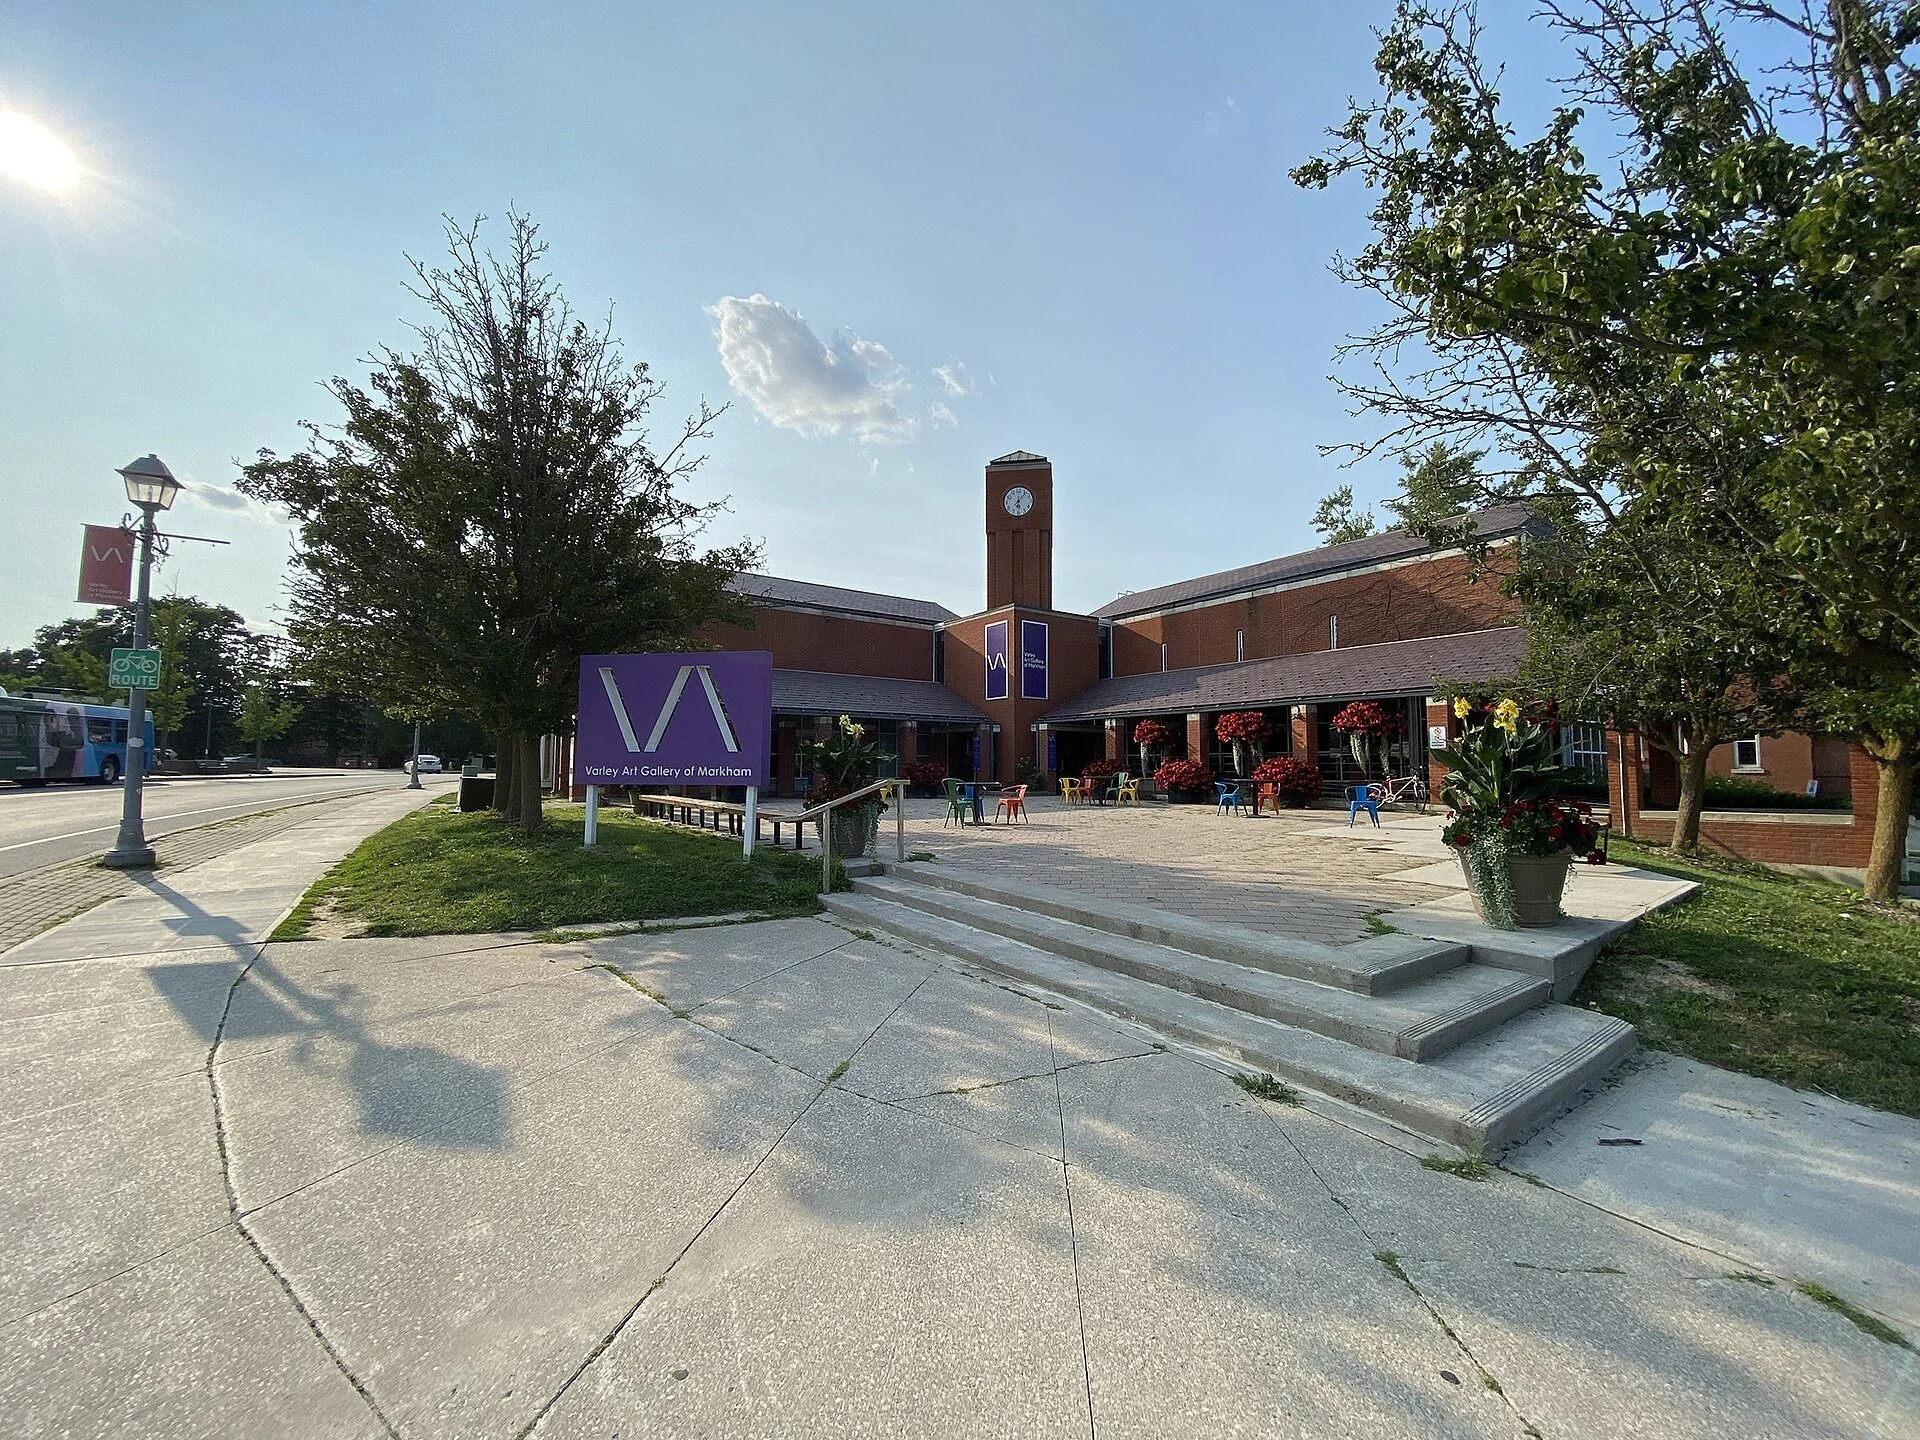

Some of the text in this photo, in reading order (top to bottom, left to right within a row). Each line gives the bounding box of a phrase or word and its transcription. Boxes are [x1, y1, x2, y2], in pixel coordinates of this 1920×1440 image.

[111, 674, 157, 686] ROUTE
[585, 765, 752, 779] Varley Art Gallery of Markham
